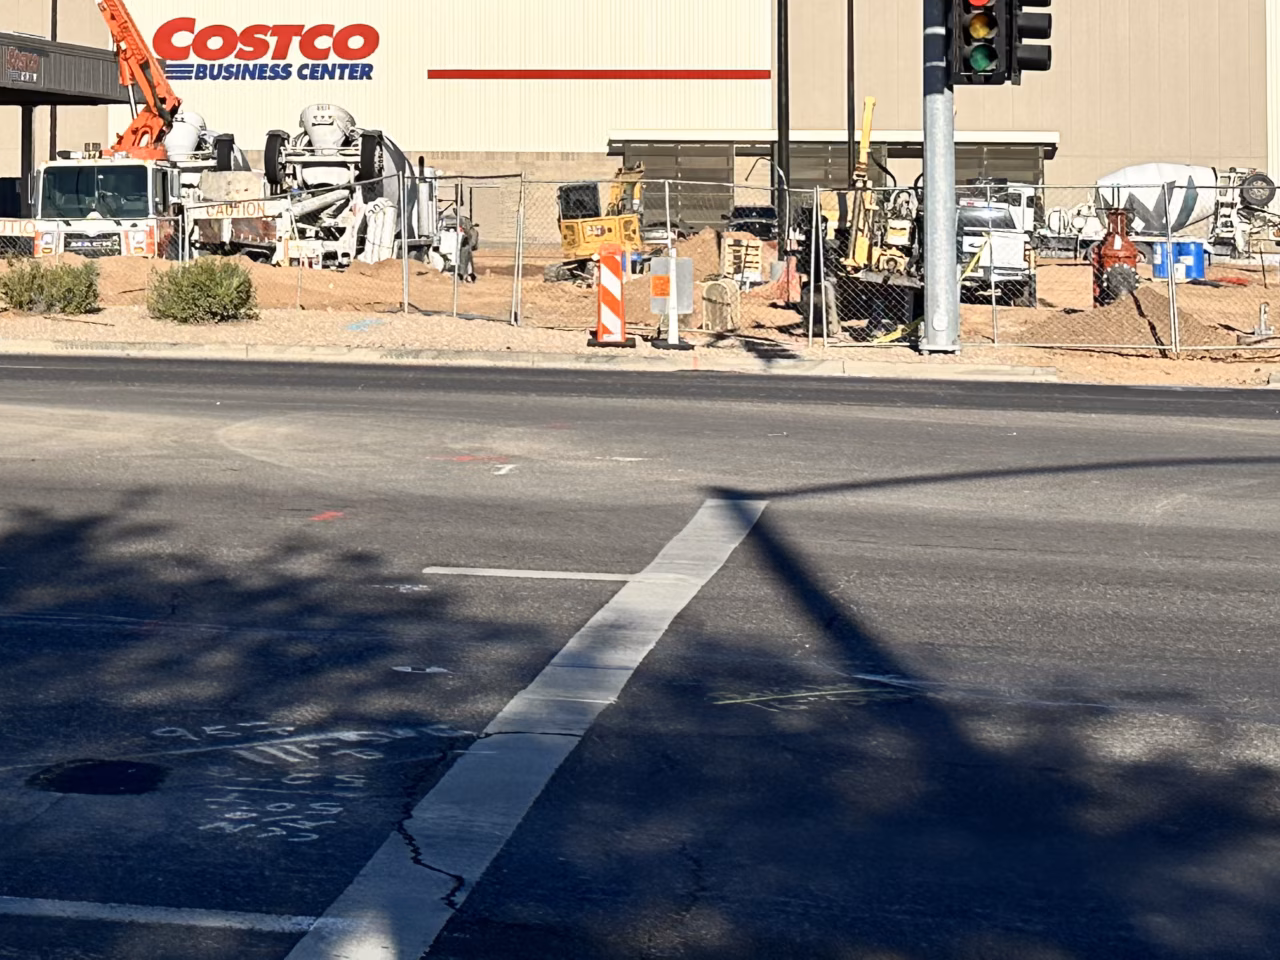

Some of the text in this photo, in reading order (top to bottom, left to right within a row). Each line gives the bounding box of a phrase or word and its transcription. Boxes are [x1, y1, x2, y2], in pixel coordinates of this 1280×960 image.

[152, 17, 380, 61] COSTCO
[194, 63, 373, 81] BUSINESS CENTER
[206, 201, 265, 217] CAUTION
